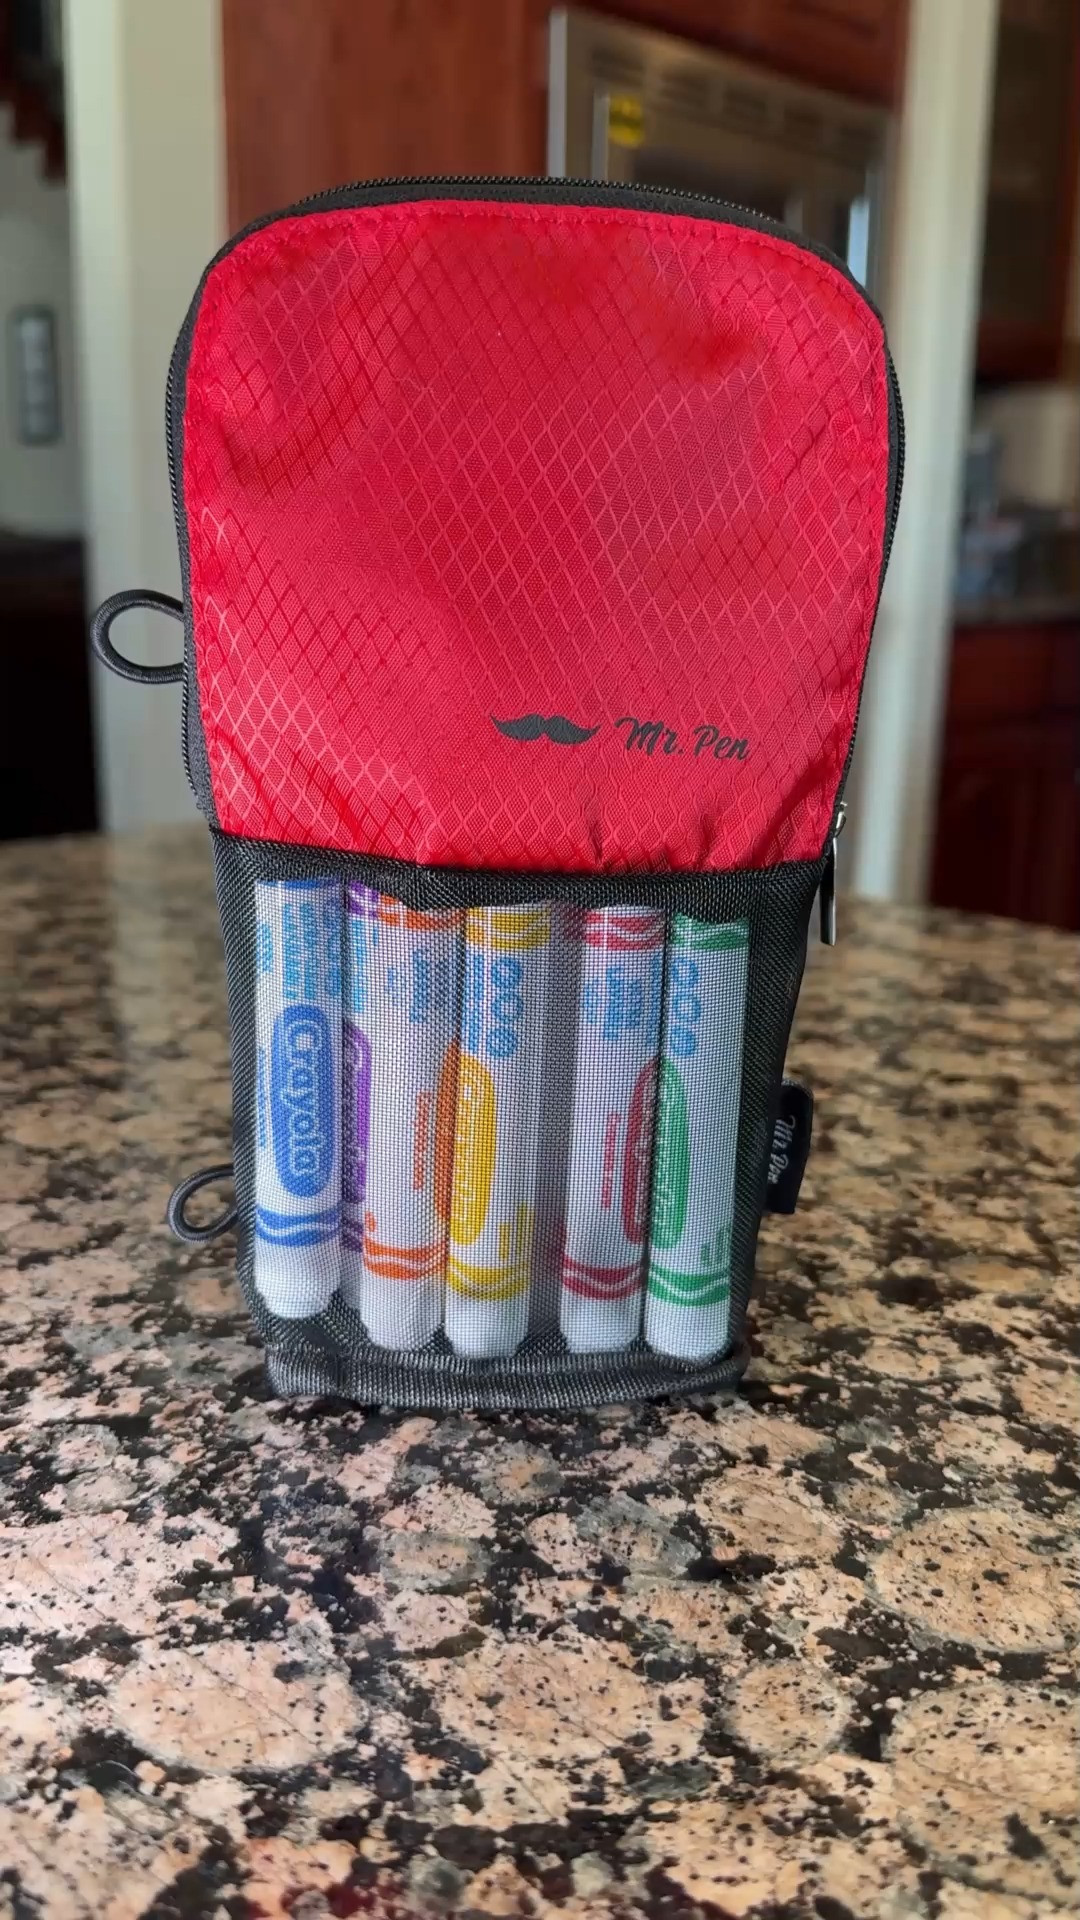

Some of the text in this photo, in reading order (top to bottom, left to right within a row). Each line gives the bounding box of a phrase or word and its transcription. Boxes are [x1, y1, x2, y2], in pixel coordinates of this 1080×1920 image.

[614, 716, 749, 761] Mr. Pen
[278, 1019, 325, 1175] Crayola
